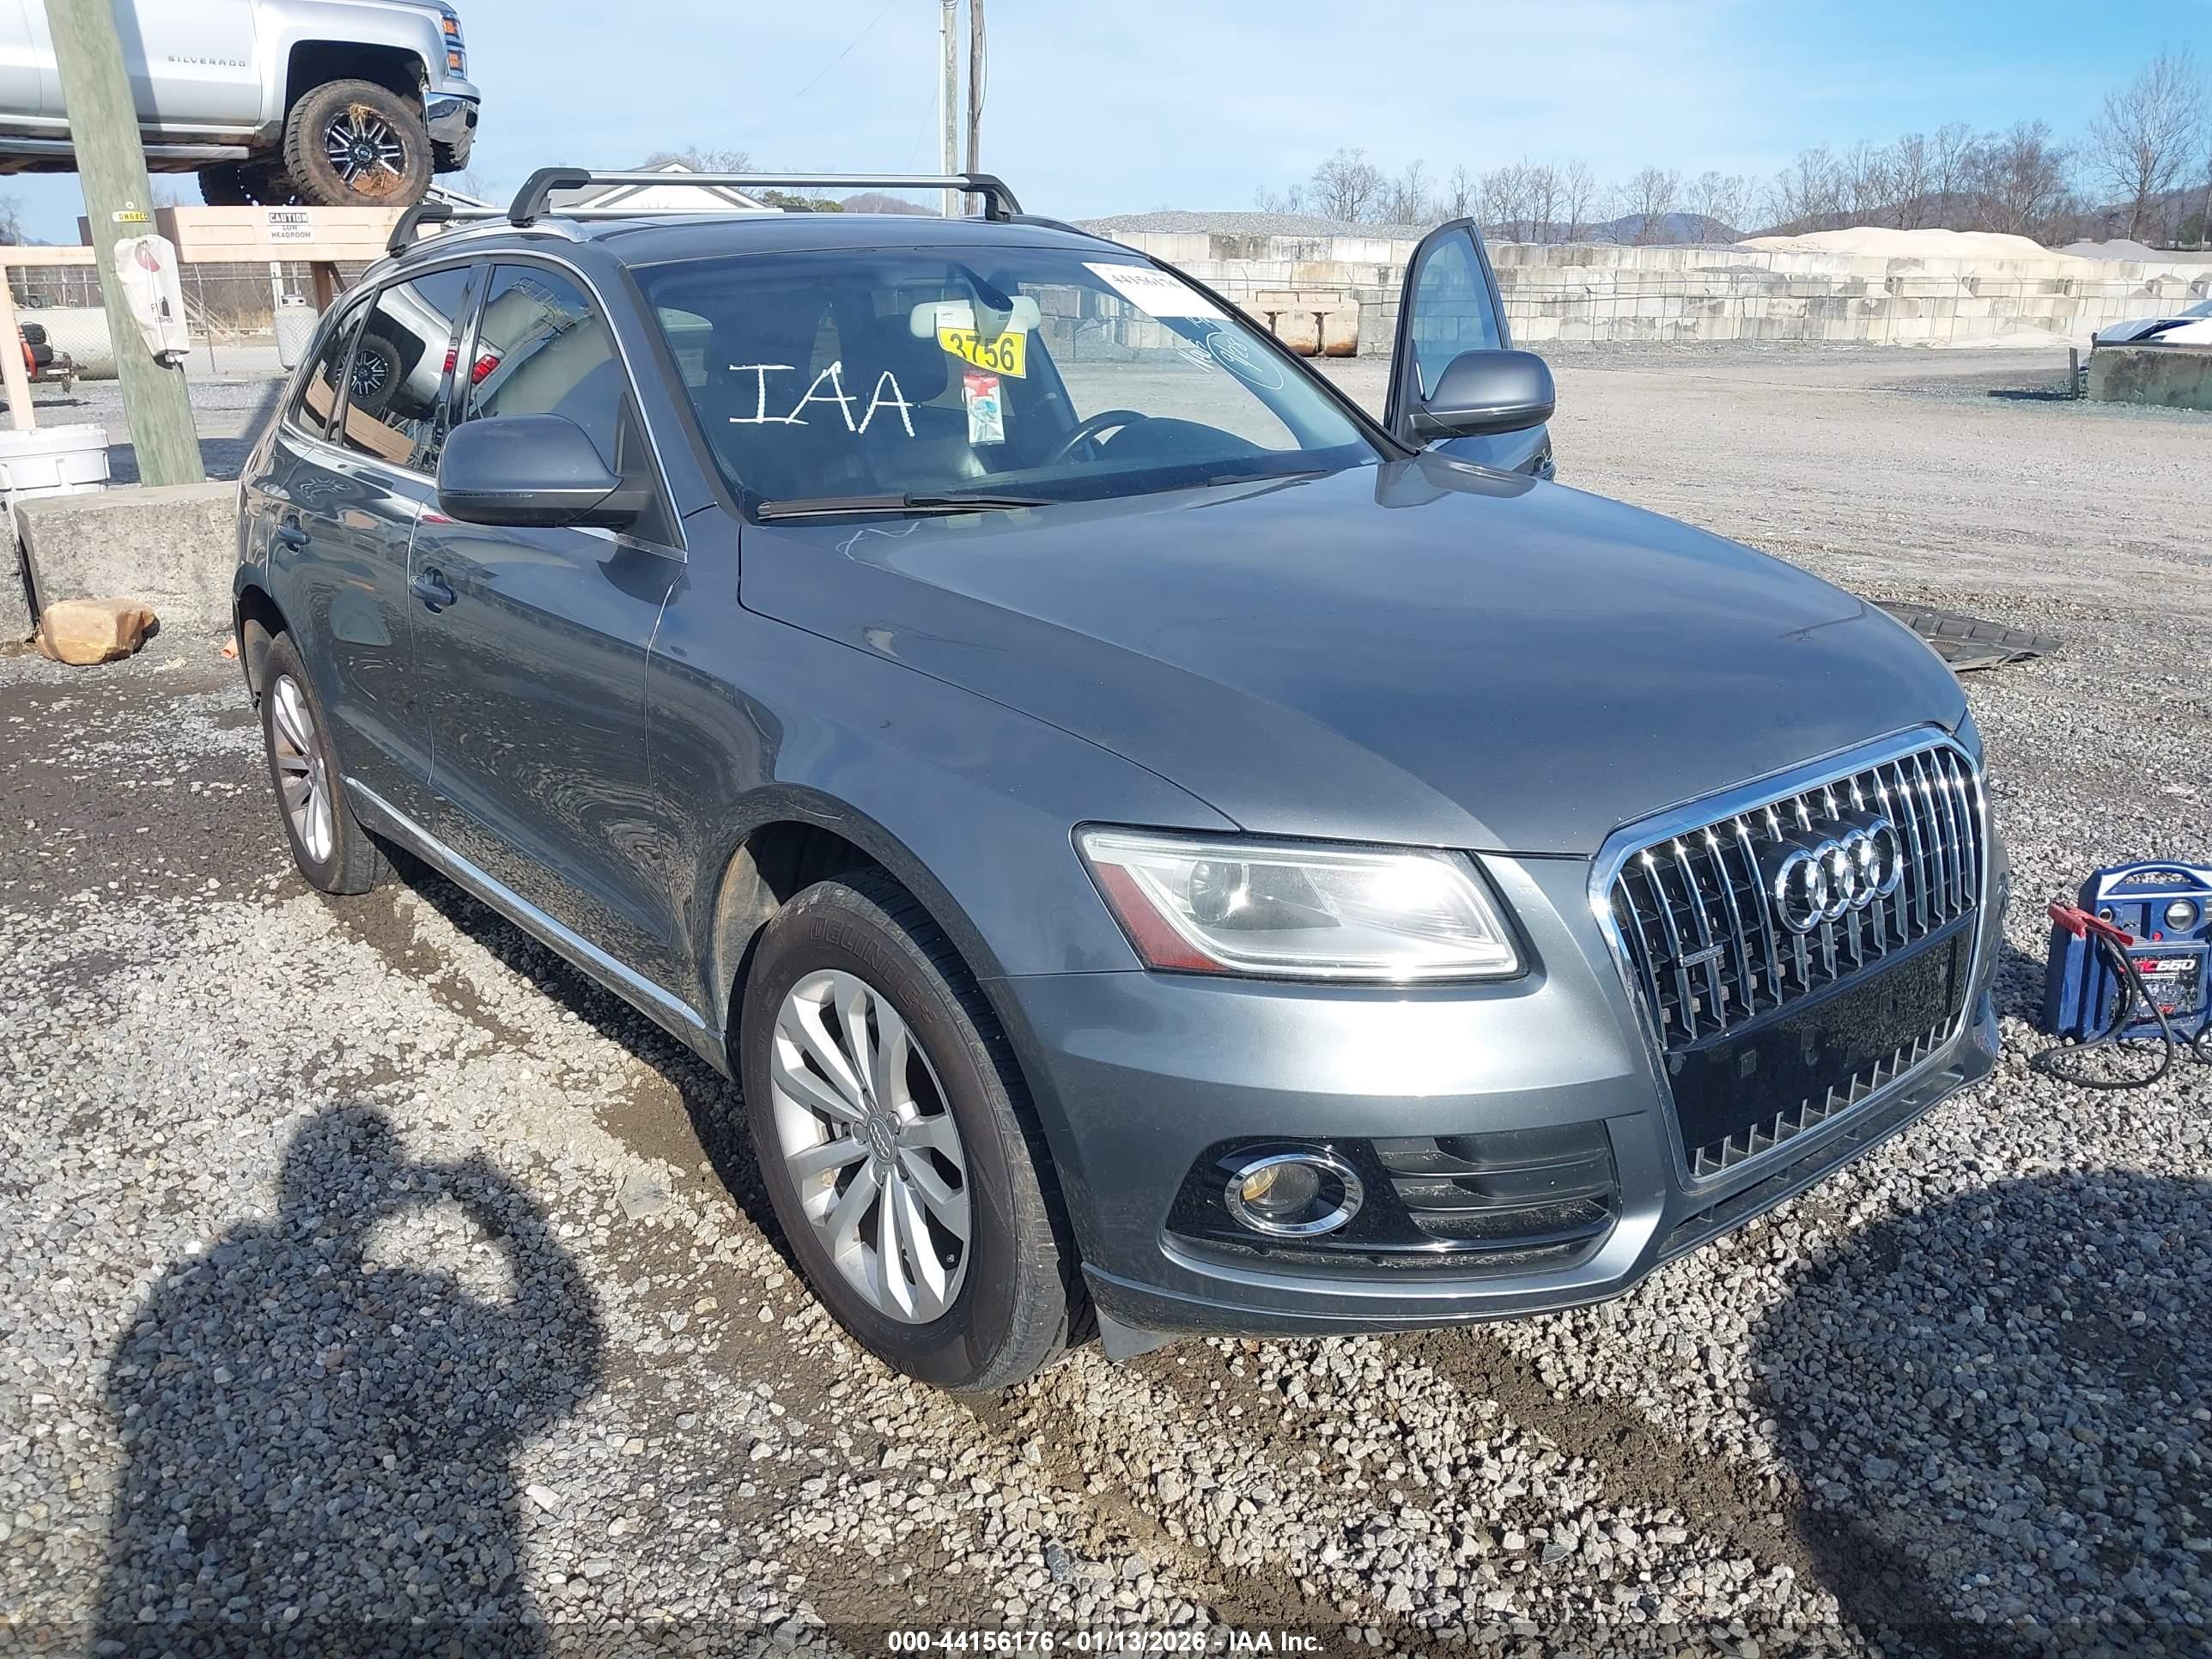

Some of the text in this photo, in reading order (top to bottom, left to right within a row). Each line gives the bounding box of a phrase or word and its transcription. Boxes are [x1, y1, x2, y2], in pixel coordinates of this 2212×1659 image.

[167, 55, 246, 67] SILVERADO
[269, 213, 308, 222] CAUTION
[1111, 274, 1182, 289] 44156176
[950, 332, 1015, 372] 3756
[729, 361, 915, 437] IAA
